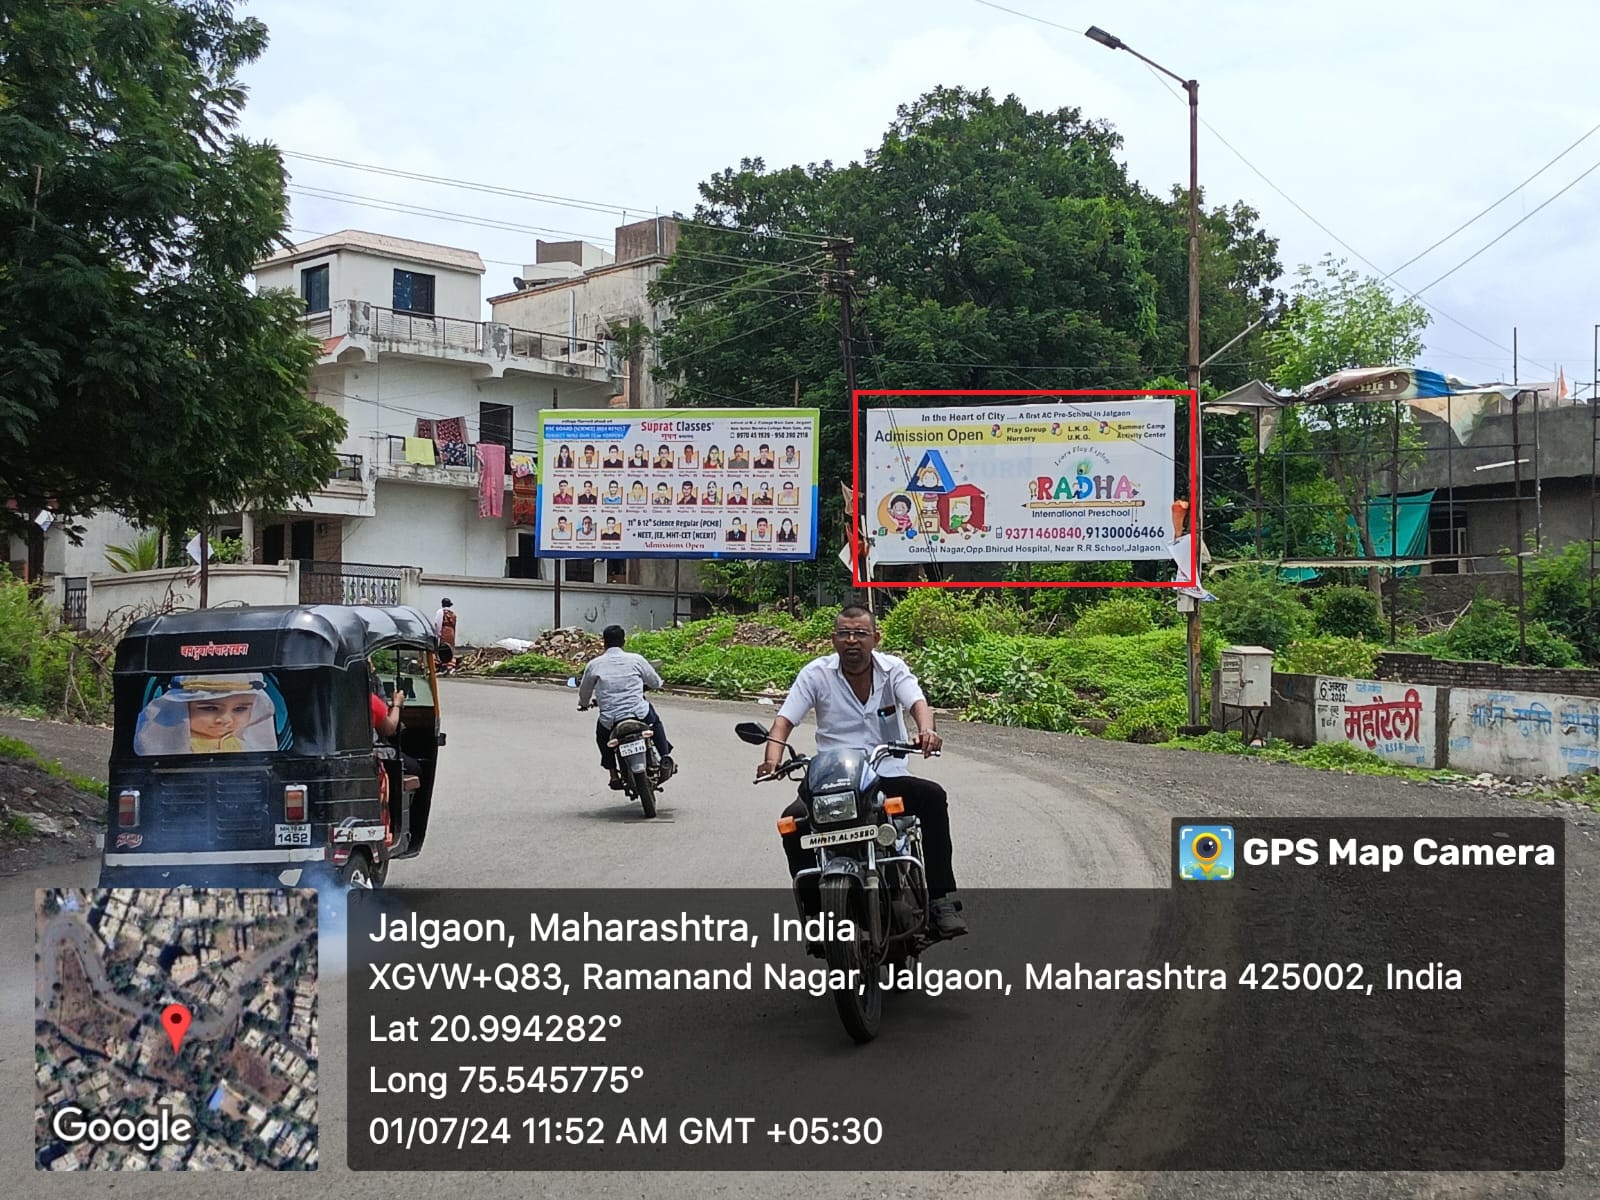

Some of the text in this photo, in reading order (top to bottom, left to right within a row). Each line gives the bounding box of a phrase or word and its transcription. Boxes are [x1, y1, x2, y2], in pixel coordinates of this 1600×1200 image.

[922, 413, 930, 422] In
[933, 413, 947, 422] the
[950, 412, 974, 422] Heart
[976, 412, 985, 421] of
[987, 411, 1006, 422] City
[1025, 411, 1040, 419] first
[1041, 411, 1052, 419] AC
[1053, 410, 1093, 418] Pre-School
[1102, 410, 1131, 418] Jalgaon
[641, 421, 712, 434] Suprat Classes
[1006, 426, 1047, 435] Play Group
[1146, 423, 1166, 431] Camp
[874, 428, 984, 444] Admission Open
[1006, 435, 1036, 443] Nursery
[1143, 431, 1167, 439] Center
[1036, 474, 1136, 500] RADHA
[1032, 508, 1131, 519] International Preschool
[652, 519, 675, 527] Science
[675, 519, 699, 528] Regular
[1005, 526, 1165, 540] 9371460840,9130006466
[908, 545, 938, 554] Gandhi
[1015, 544, 1053, 554] Hospital,
[1054, 544, 1075, 553] Near
[1320, 681, 1328, 699] 6
[278, 833, 308, 843] 1452
